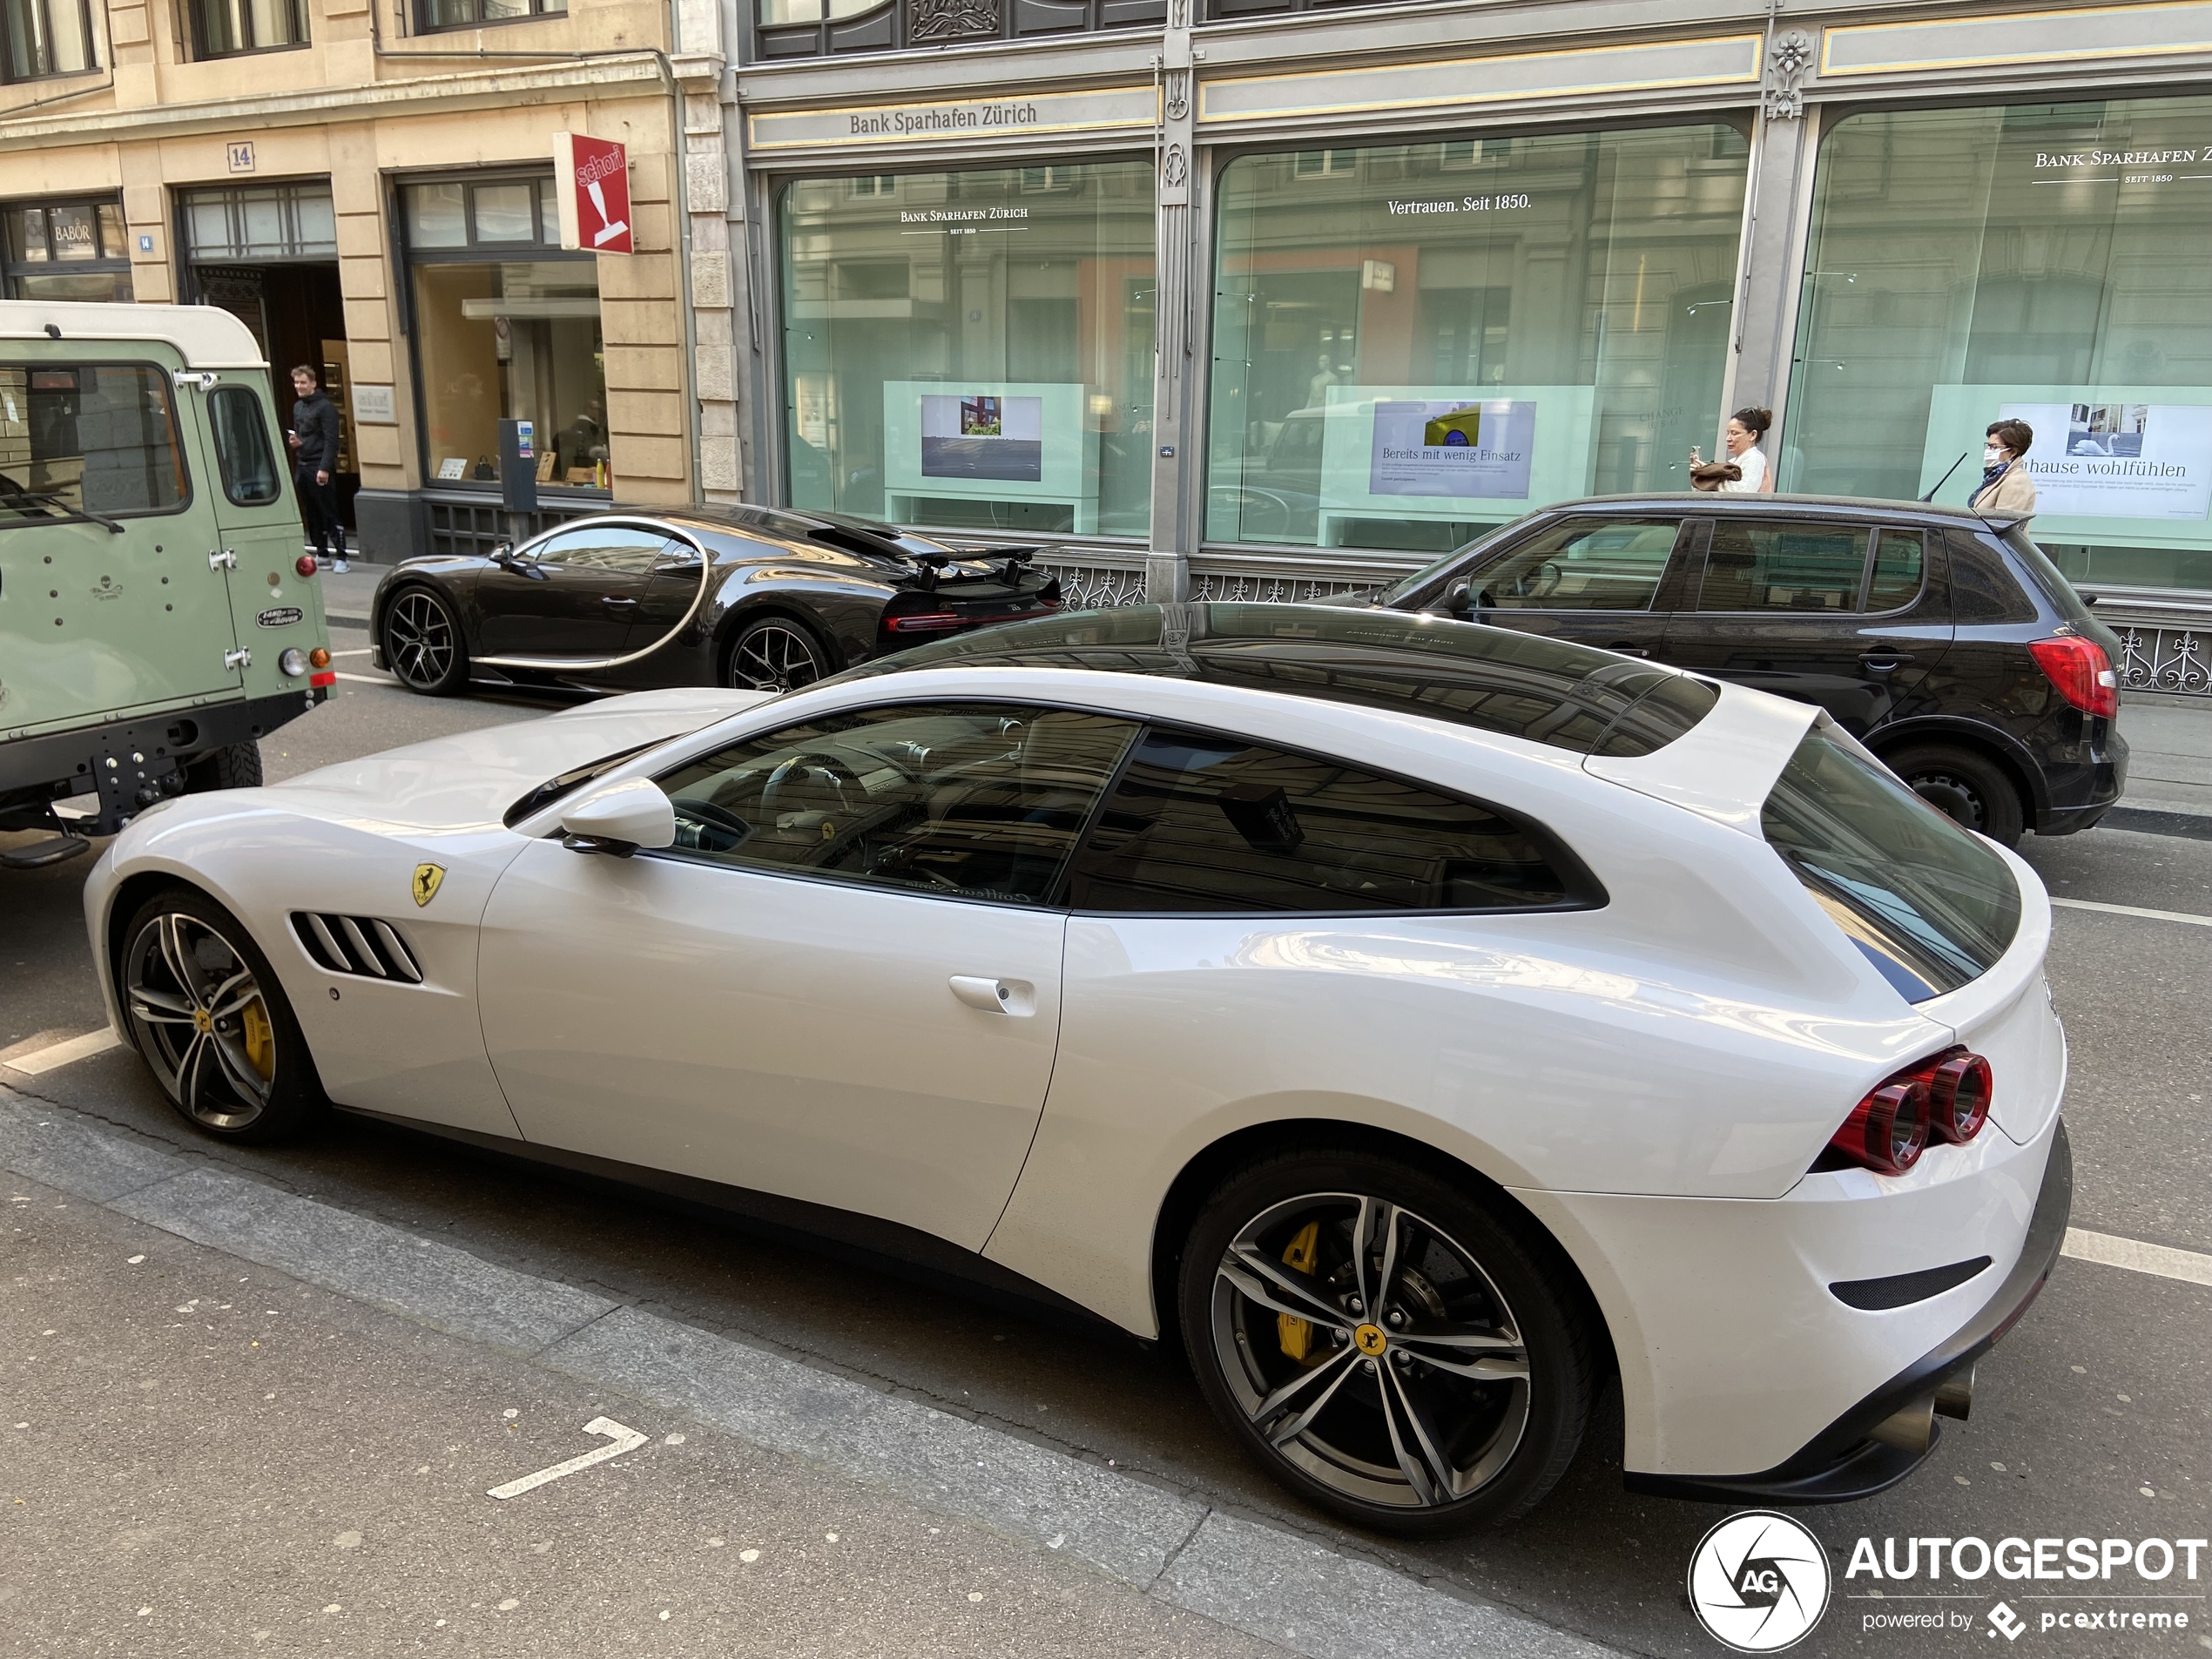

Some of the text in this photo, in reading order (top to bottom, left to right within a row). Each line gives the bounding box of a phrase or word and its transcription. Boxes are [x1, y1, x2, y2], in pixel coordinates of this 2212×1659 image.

[850, 103, 1037, 135] Bank Sparhafen Zürich
[233, 146, 250, 166] 14
[2034, 152, 2086, 168] BANK
[2090, 150, 2197, 165] SPARHAFEN
[577, 145, 625, 187] schori
[2125, 174, 2173, 184] SEIT 1850
[1387, 193, 1532, 215] Vertrauen. Seit 1850.
[900, 207, 1028, 223] BANK SPARHAFEN ZÜRICH
[55, 225, 91, 240] BABOR
[1383, 448, 1521, 462] Bereits mit wenig Einsatz
[2025, 458, 2187, 477] hause wohlfühlen
